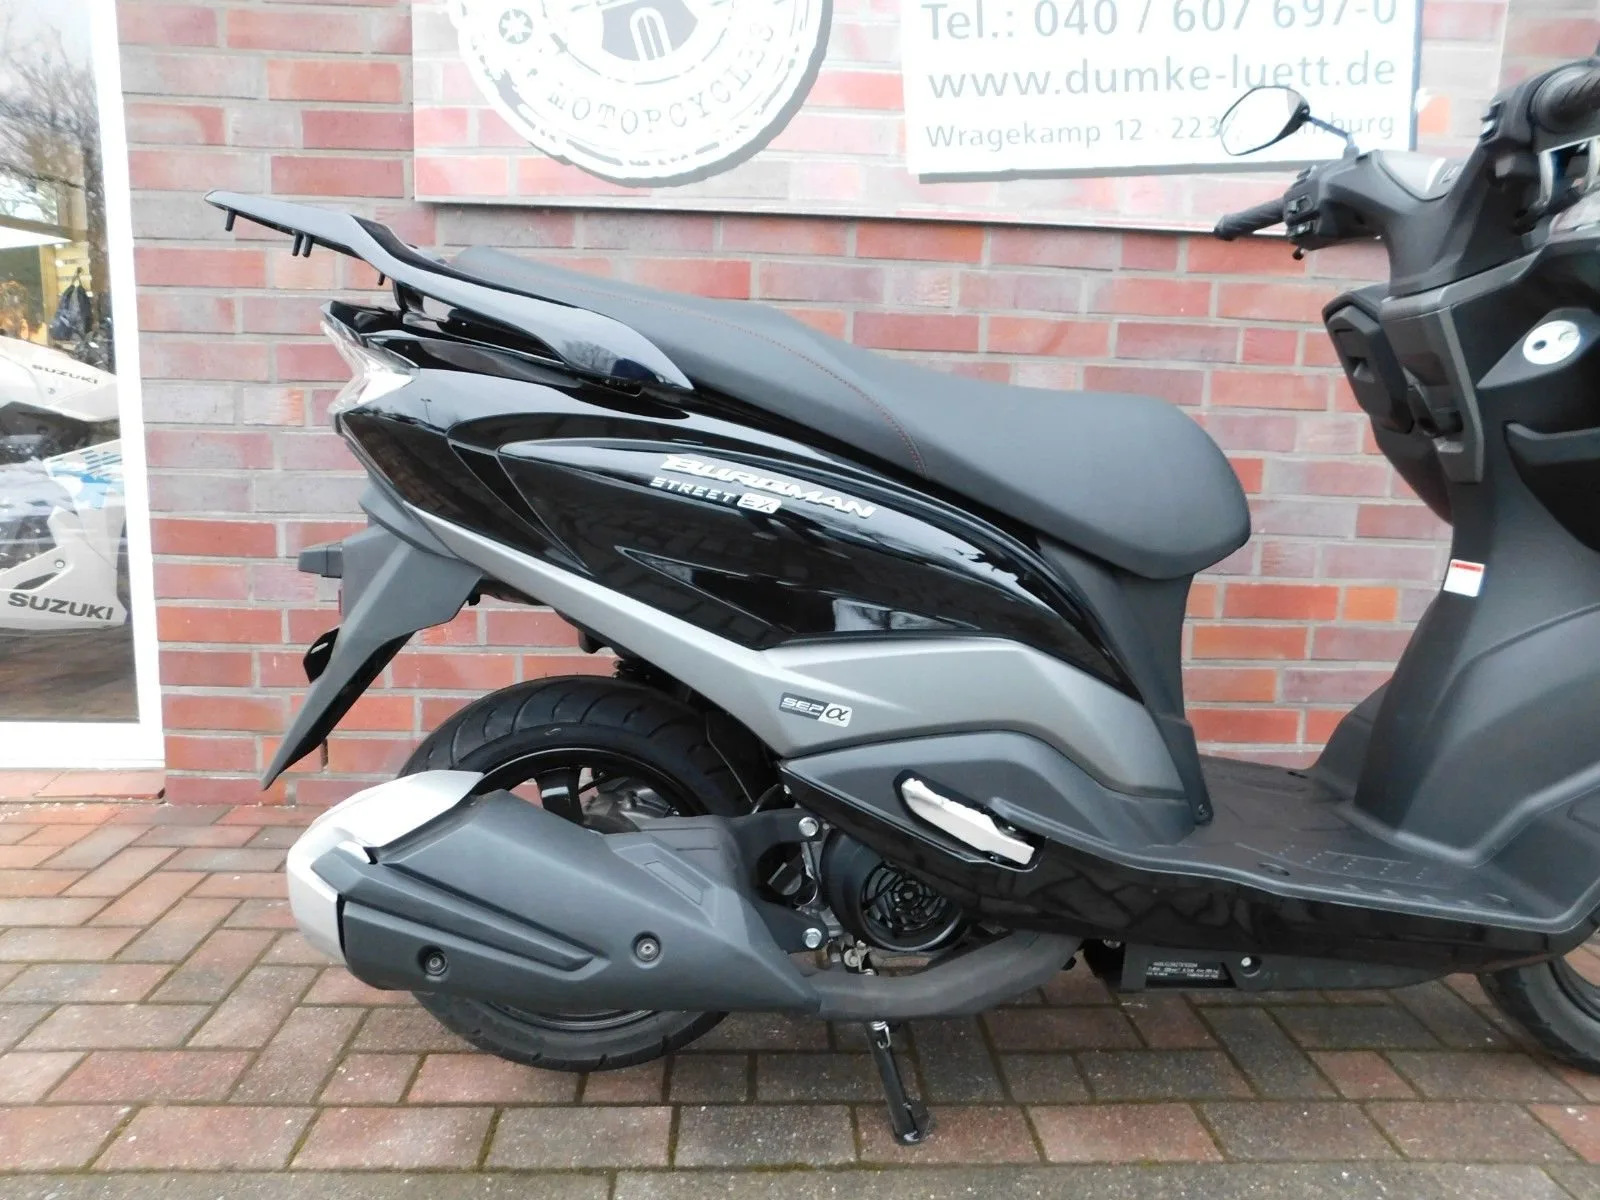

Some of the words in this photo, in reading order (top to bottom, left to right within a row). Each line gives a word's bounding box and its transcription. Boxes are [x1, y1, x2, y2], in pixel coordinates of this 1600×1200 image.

[921, 0, 1014, 40] Tel.:
[1034, 0, 1118, 37] 040
[1137, 0, 1152, 34] /
[927, 51, 1396, 99] www.dumke-luett.de
[925, 117, 1102, 152] Wragekamp
[1116, 119, 1144, 141] 12
[31, 364, 98, 385] SUZUKI
[650, 476, 737, 503] STREET
[7, 592, 115, 621] SUZUKI
